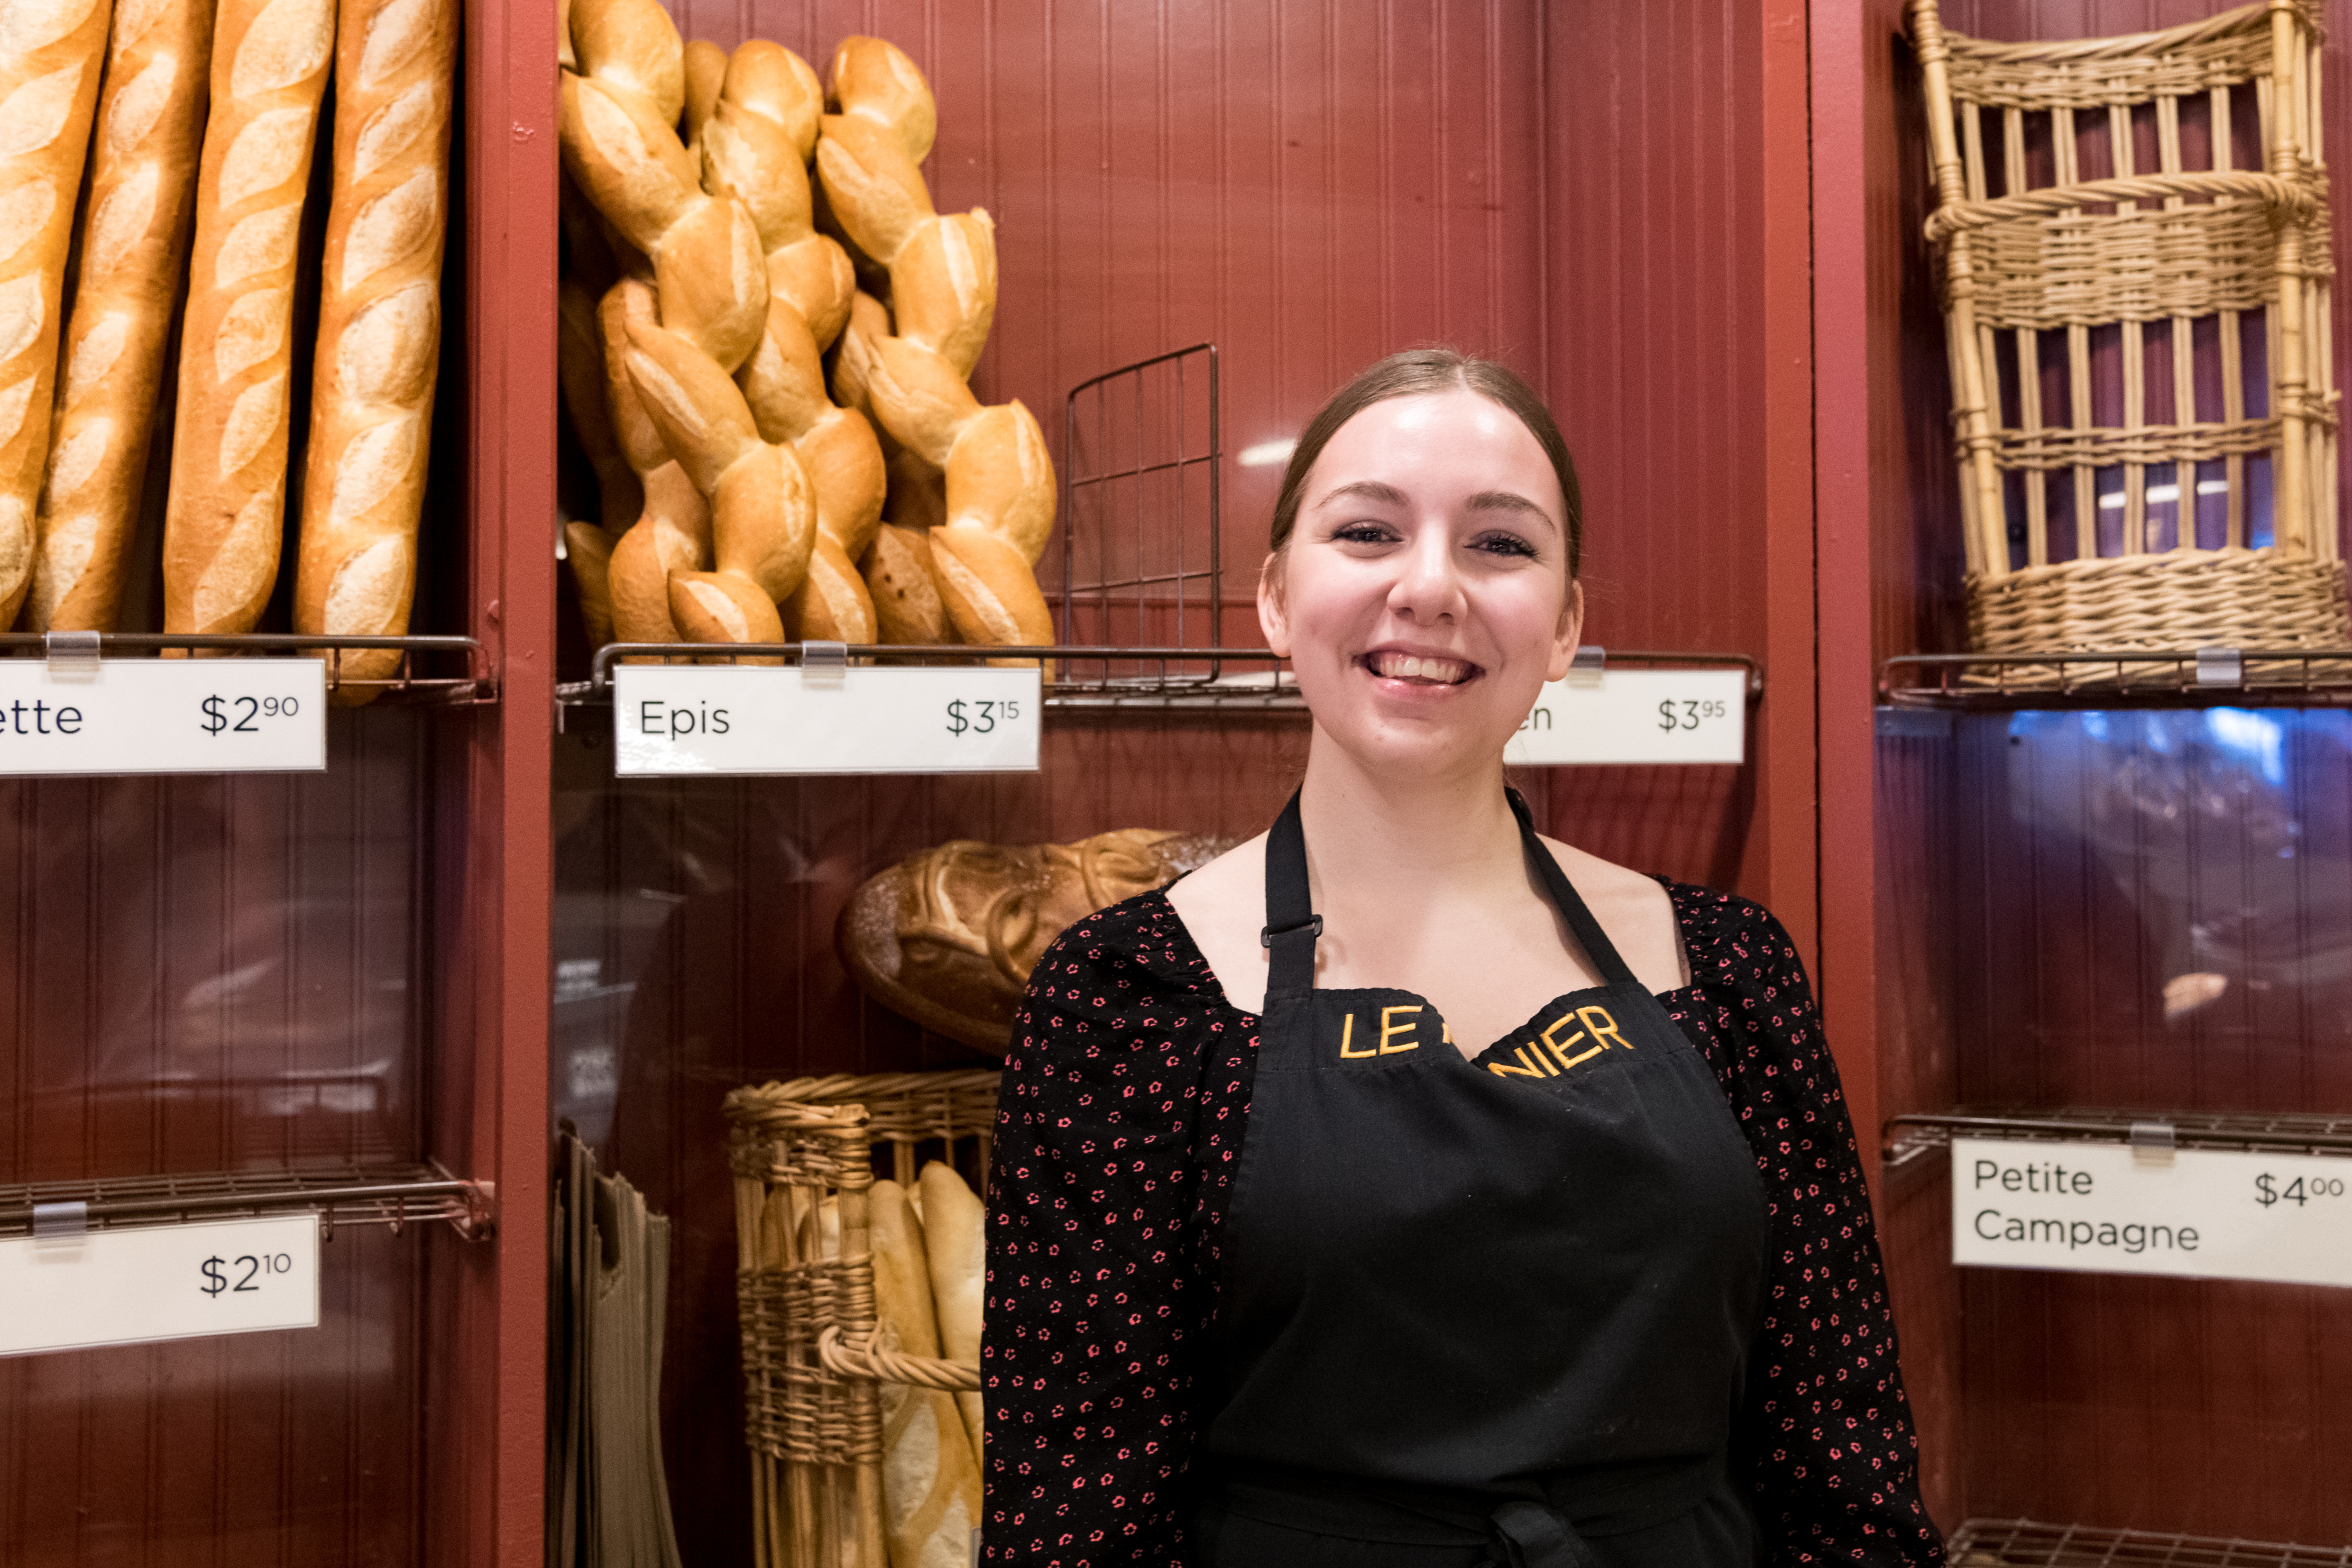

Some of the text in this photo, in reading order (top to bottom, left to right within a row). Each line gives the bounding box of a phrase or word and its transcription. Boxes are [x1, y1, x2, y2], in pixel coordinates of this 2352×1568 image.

[641, 700, 730, 741] Epis
[1340, 1005, 1635, 1079] LE NIER
[1975, 1160, 2093, 1195] Petite
[1975, 1209, 2200, 1254] Campagne
